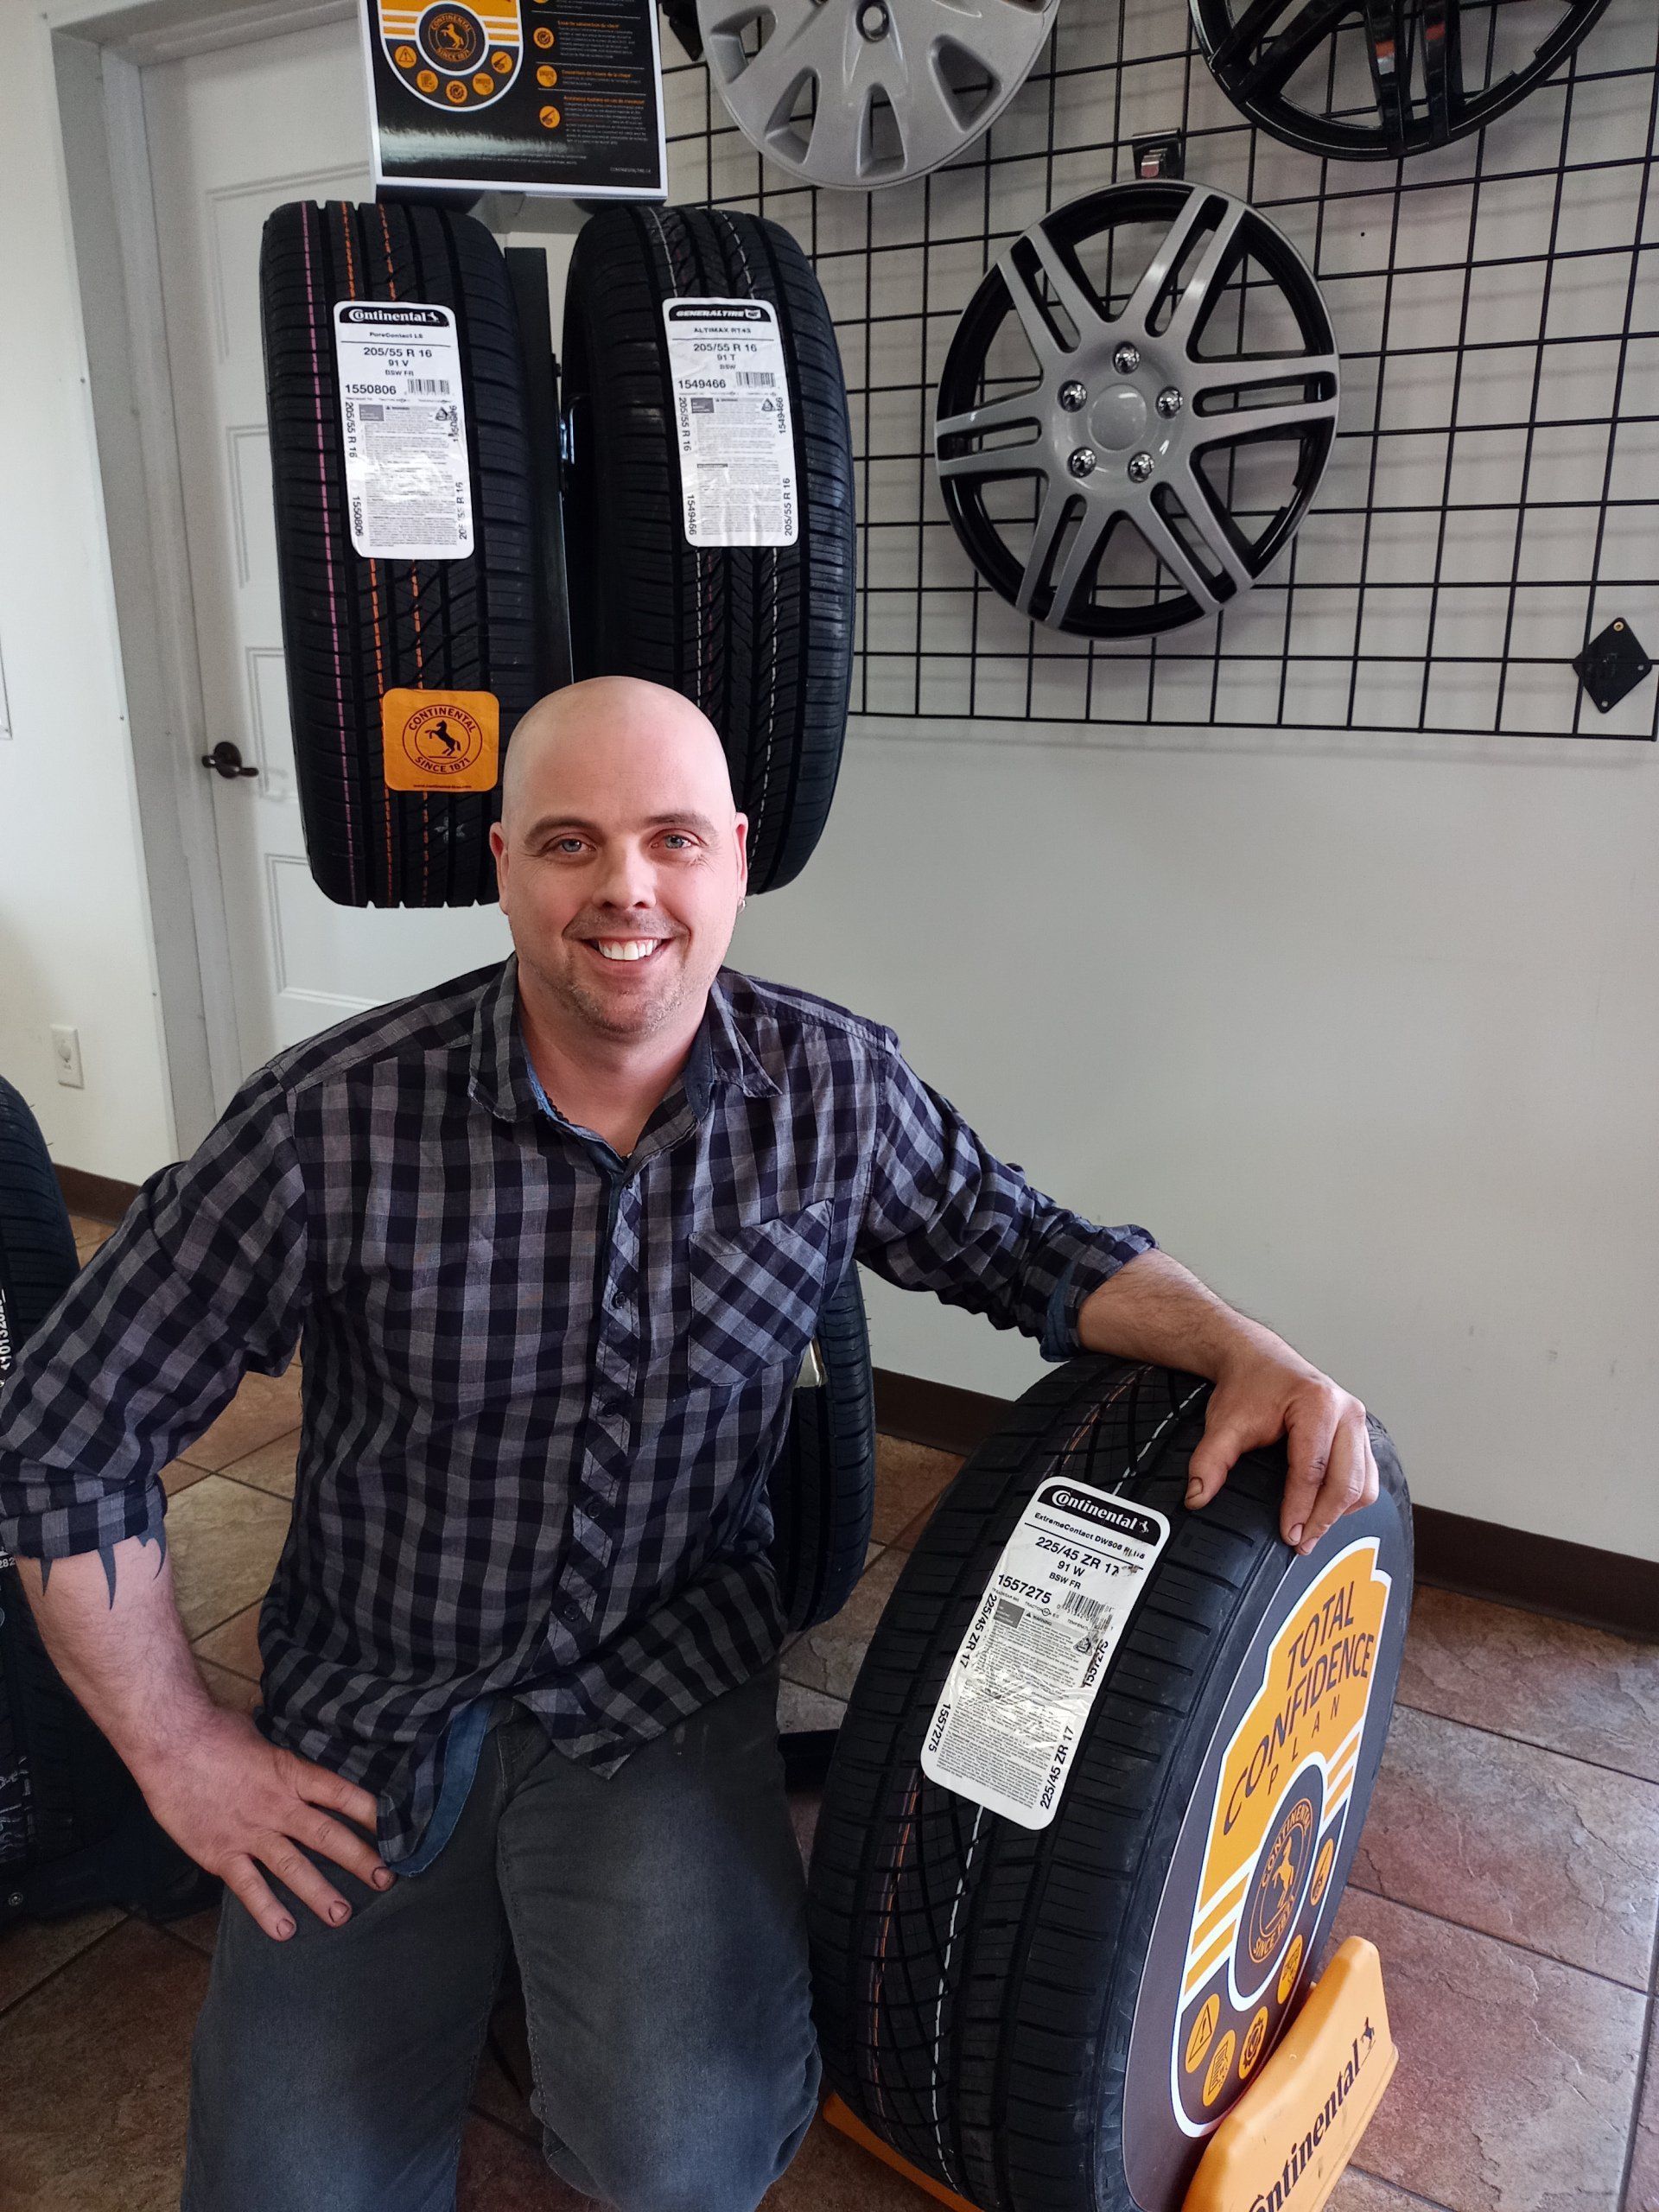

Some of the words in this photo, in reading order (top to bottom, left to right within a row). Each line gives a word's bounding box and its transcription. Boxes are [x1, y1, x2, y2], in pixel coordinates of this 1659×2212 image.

[348, 308, 426, 322] Continental
[363, 347, 403, 356] 205/55
[418, 349, 432, 358] 16
[694, 343, 729, 352] 205/55
[346, 385, 397, 395] 1550806
[678, 379, 726, 389] 1549466
[346, 402, 355, 433] 205/55
[678, 397, 689, 427] 205/55
[776, 397, 785, 434] 1549466
[349, 447, 358, 457] 16
[683, 442, 691, 451] 16
[783, 478, 791, 488] 16
[353, 496, 364, 537] 1550806
[687, 494, 696, 536] 1549466
[784, 503, 792, 536] 205/55
[409, 707, 476, 734] CONTINENTAL
[415, 756, 447, 772] SINCE
[449, 757, 471, 772] 1871
[1052, 1490, 1138, 1530] Continental
[1035, 1512, 1093, 1541] ExtremeContact
[1035, 1536, 1079, 1560] 225/45
[1081, 1554, 1102, 1569] ZR
[1105, 1563, 1120, 1576] 17
[1057, 1560, 1071, 1572] 91
[1073, 1567, 1085, 1577] W
[998, 1573, 1052, 1605] 1557275
[1049, 1572, 1068, 1585] BSW
[1069, 1580, 1081, 1590] FR
[975, 1593, 997, 1632] 225/45
[1033, 1614, 1052, 1626] WARNING
[966, 1632, 981, 1651] ZR
[1287, 1580, 1355, 1691] TOTAL
[959, 1654, 970, 1669] 17
[929, 1704, 950, 1752] 1557275
[1224, 1632, 1375, 1836] CONFIDENCE
[1039, 1765, 1061, 1809] 225/45
[1054, 1745, 1068, 1765] ZR
[1063, 1726, 1073, 1741] 17
[1262, 1803, 1311, 1888] CONTINENTAL
[1254, 1933, 1275, 1958] SINCE
[1249, 2037, 1360, 2212] ntinental
